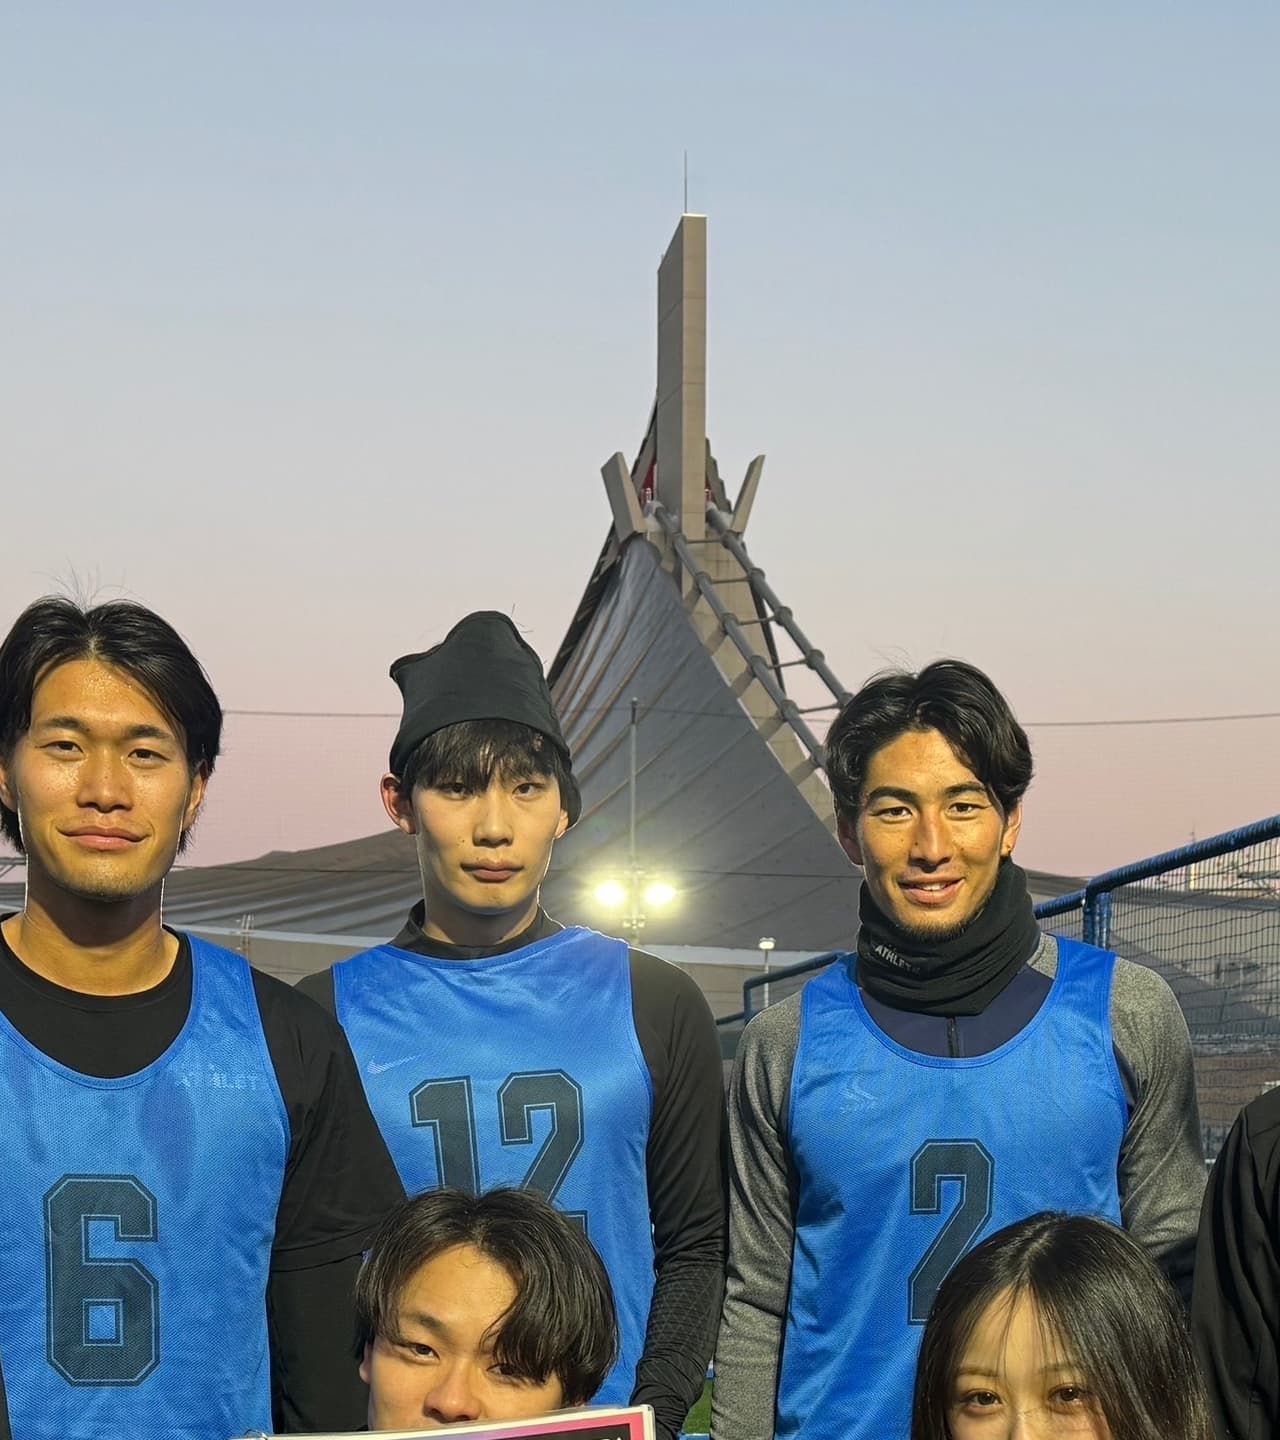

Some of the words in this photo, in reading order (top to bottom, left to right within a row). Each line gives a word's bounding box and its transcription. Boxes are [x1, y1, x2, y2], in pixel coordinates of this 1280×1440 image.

[873, 944, 918, 974] ATHLET
[408, 1069, 587, 1240] 12
[907, 1137, 995, 1327] 2
[42, 1173, 160, 1388] 6
